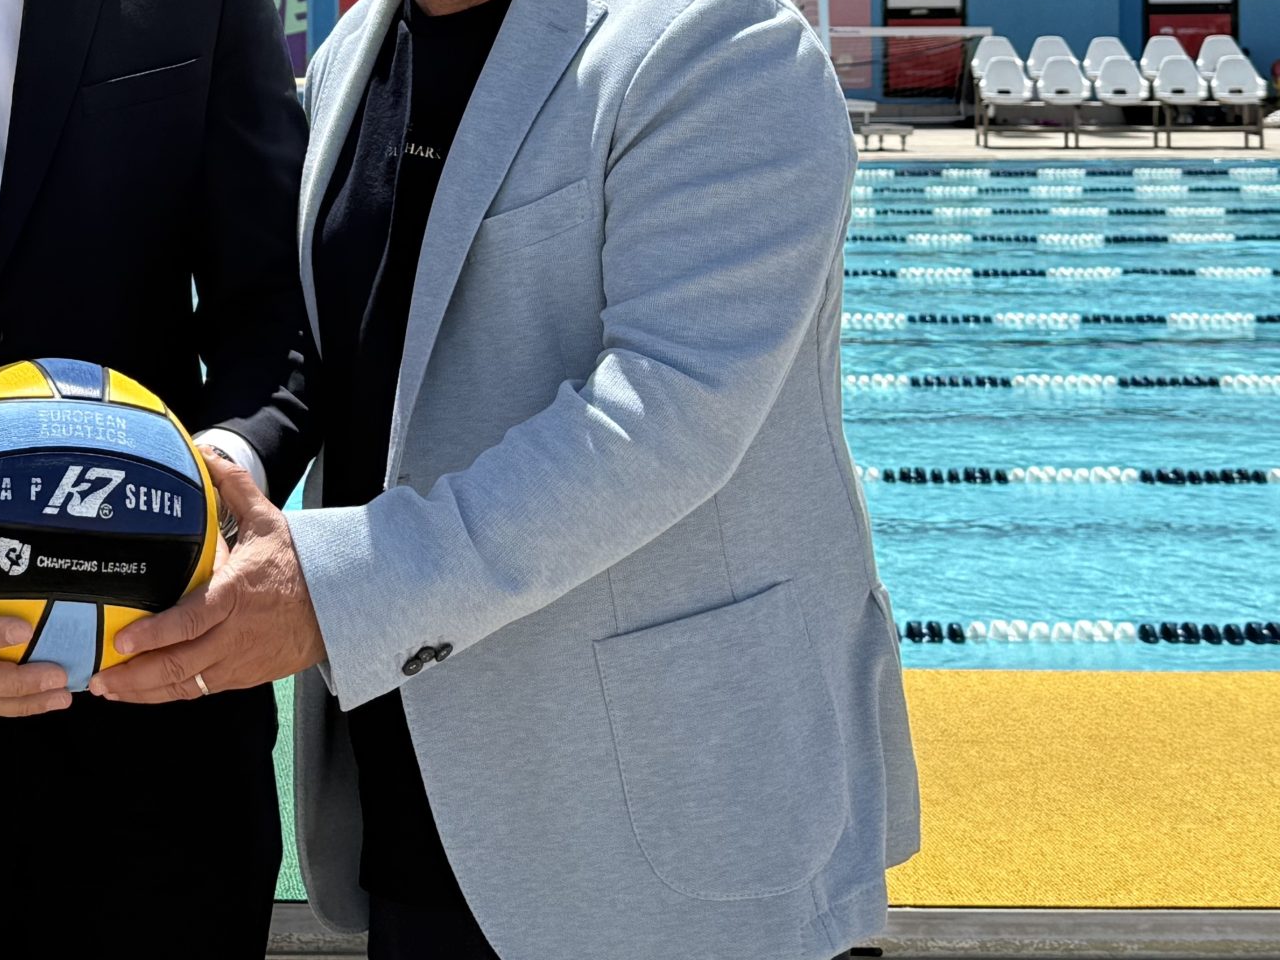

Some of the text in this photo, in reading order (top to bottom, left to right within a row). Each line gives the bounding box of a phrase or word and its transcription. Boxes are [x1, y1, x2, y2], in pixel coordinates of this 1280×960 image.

[38, 409, 127, 430] EUROPEAN
[40, 424, 127, 445] AQUATICS
[125, 483, 182, 518] SEVEN
[36, 555, 98, 573] CHAMPIONS
[101, 561, 138, 575] LEAGUE
